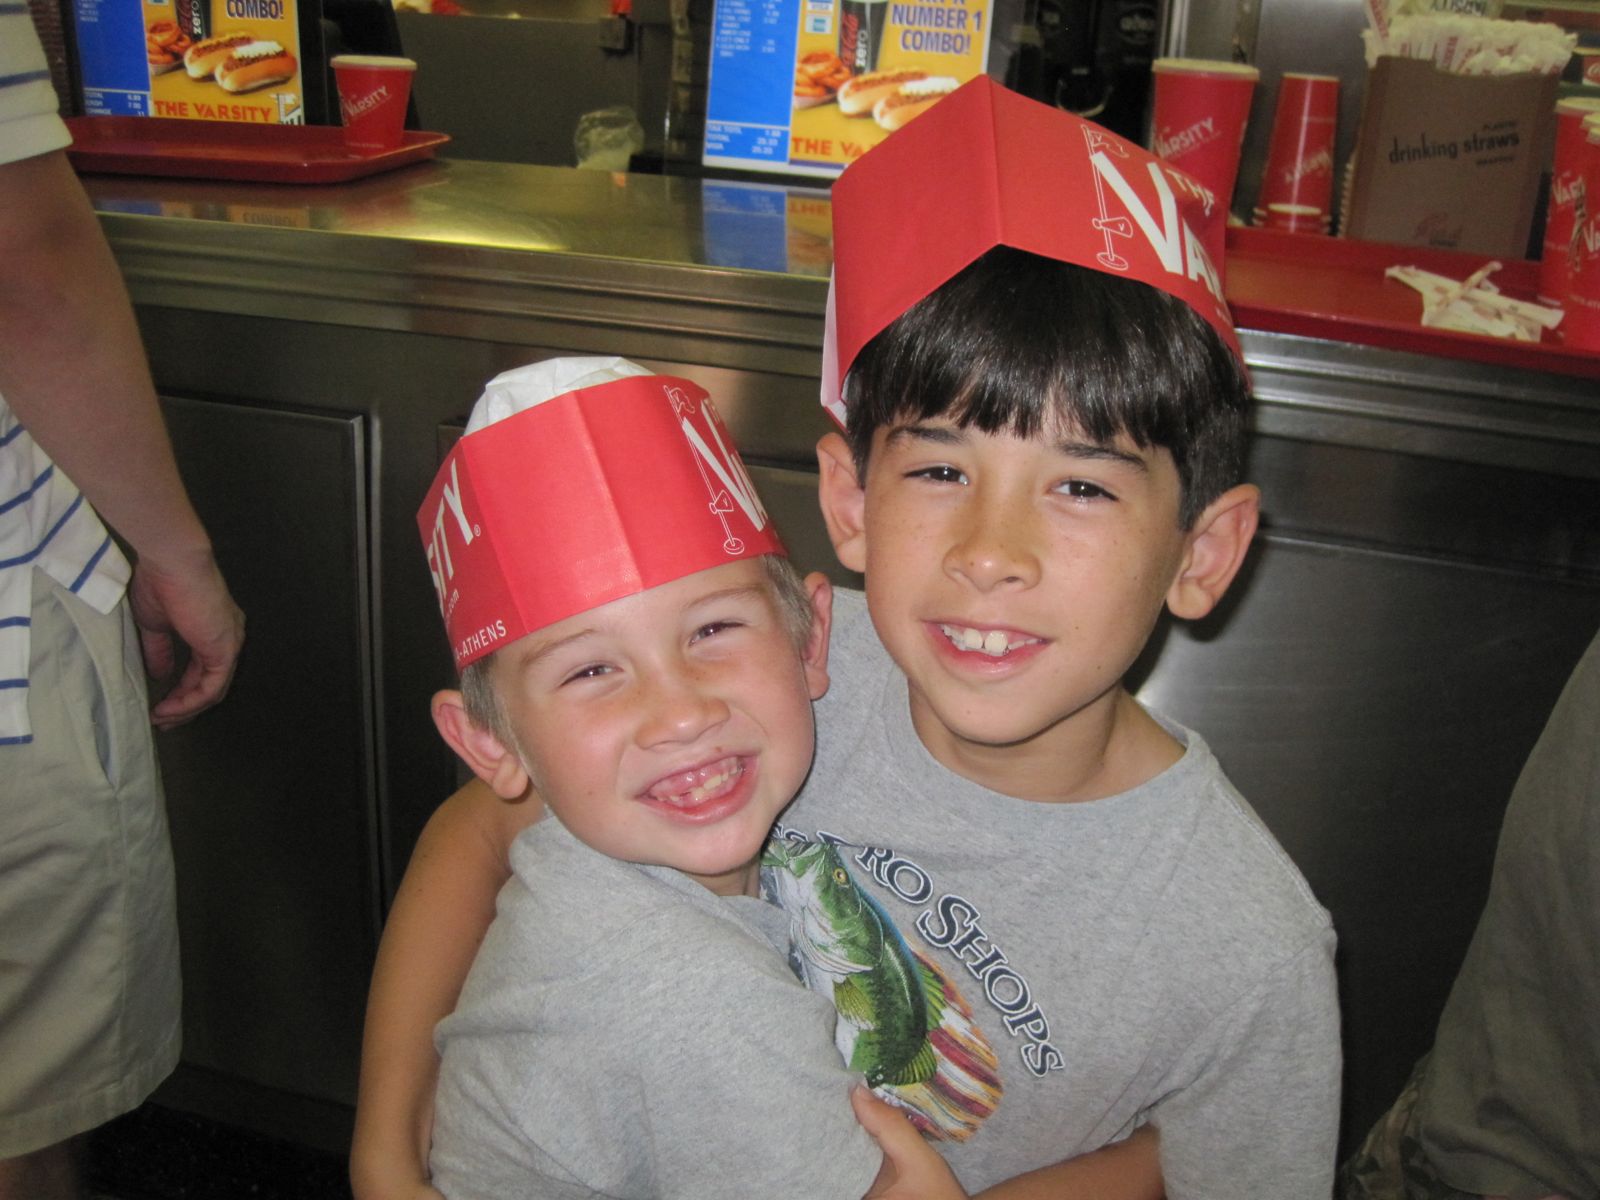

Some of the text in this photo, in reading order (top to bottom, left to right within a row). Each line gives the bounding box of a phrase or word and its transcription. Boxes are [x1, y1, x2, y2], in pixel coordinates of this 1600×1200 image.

[226, 0, 283, 20] COMBO!
[892, 5, 982, 31] NUMBER 1
[853, 30, 868, 67] zero
[901, 29, 972, 55] COMBO!
[154, 100, 272, 122] THE VARSITY
[344, 84, 389, 117] VARSITY
[793, 137, 833, 157] THE
[840, 141, 876, 159] VA
[1155, 116, 1215, 158] VARSITY
[1388, 131, 1520, 164] drinking straws
[916, 893, 1065, 1078] SHOPS
